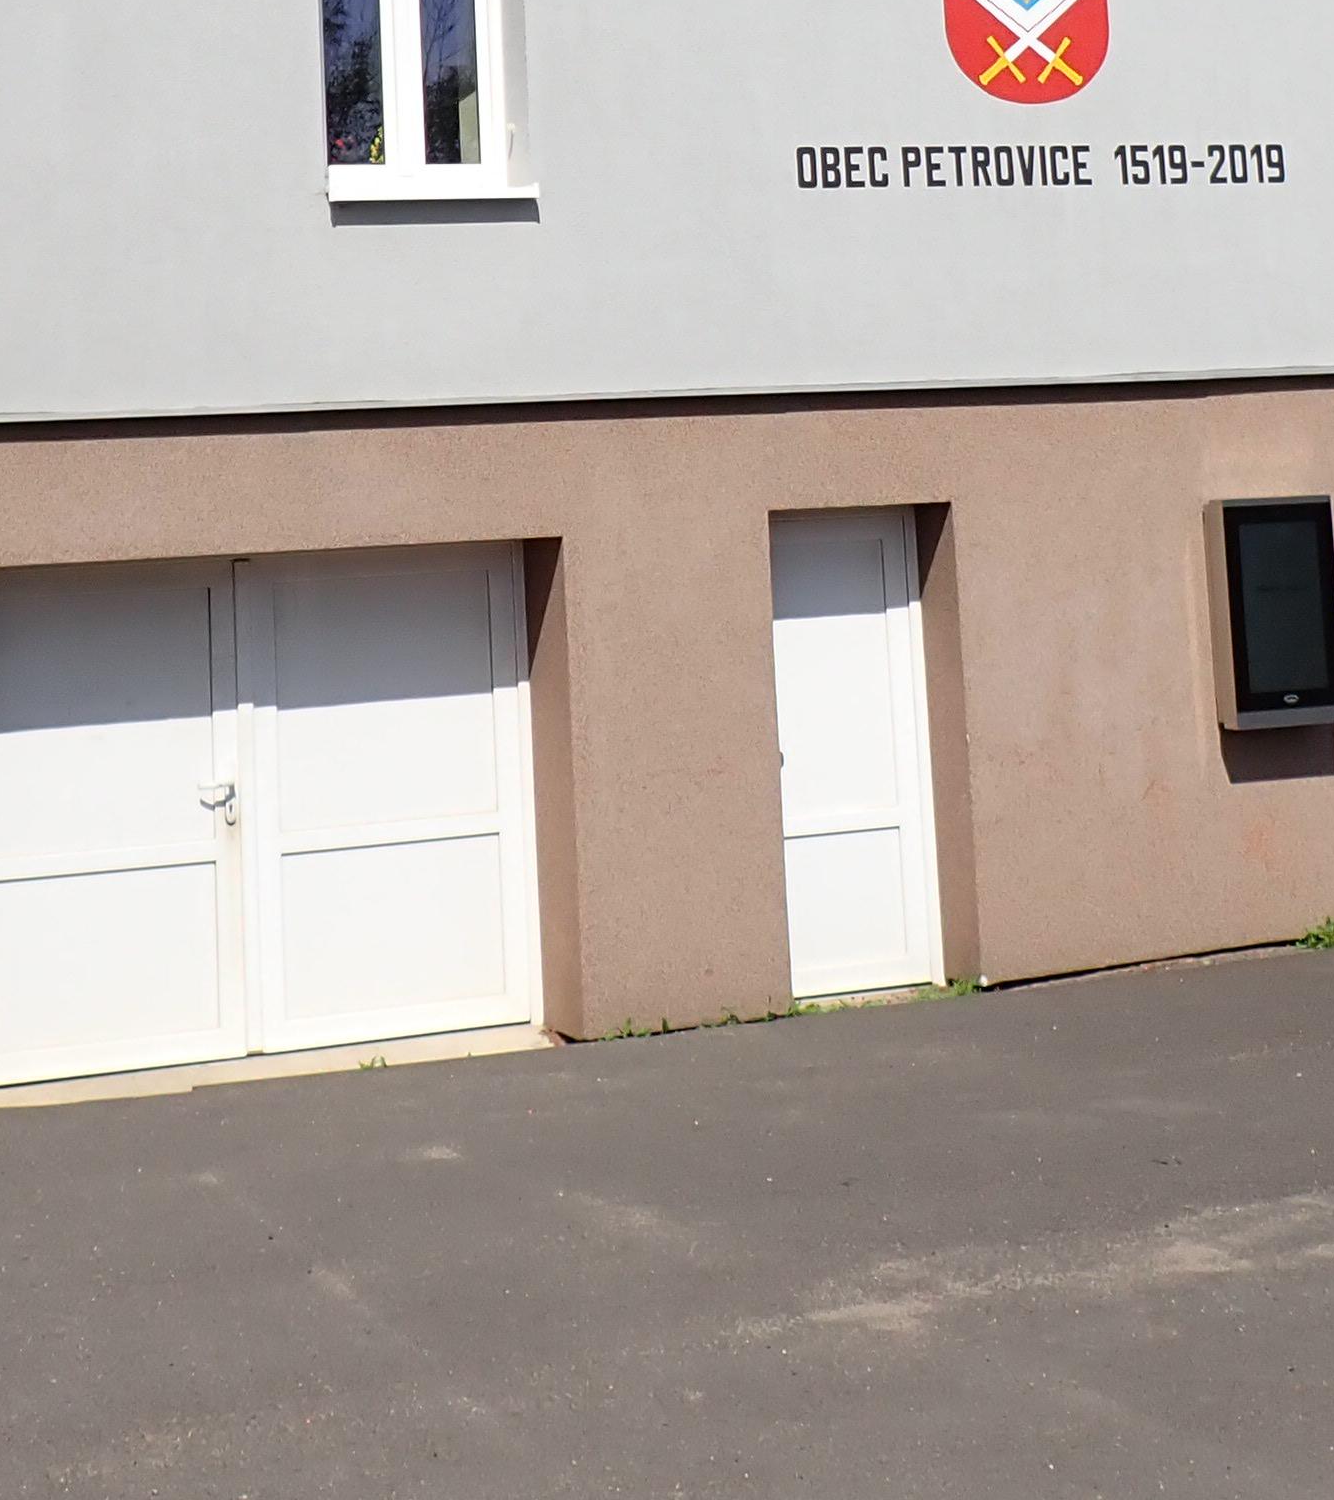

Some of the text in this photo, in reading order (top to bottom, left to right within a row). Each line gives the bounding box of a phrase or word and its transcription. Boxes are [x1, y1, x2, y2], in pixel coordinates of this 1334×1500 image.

[796, 144, 1285, 189] OBEC PETROVICE 1519-2019
